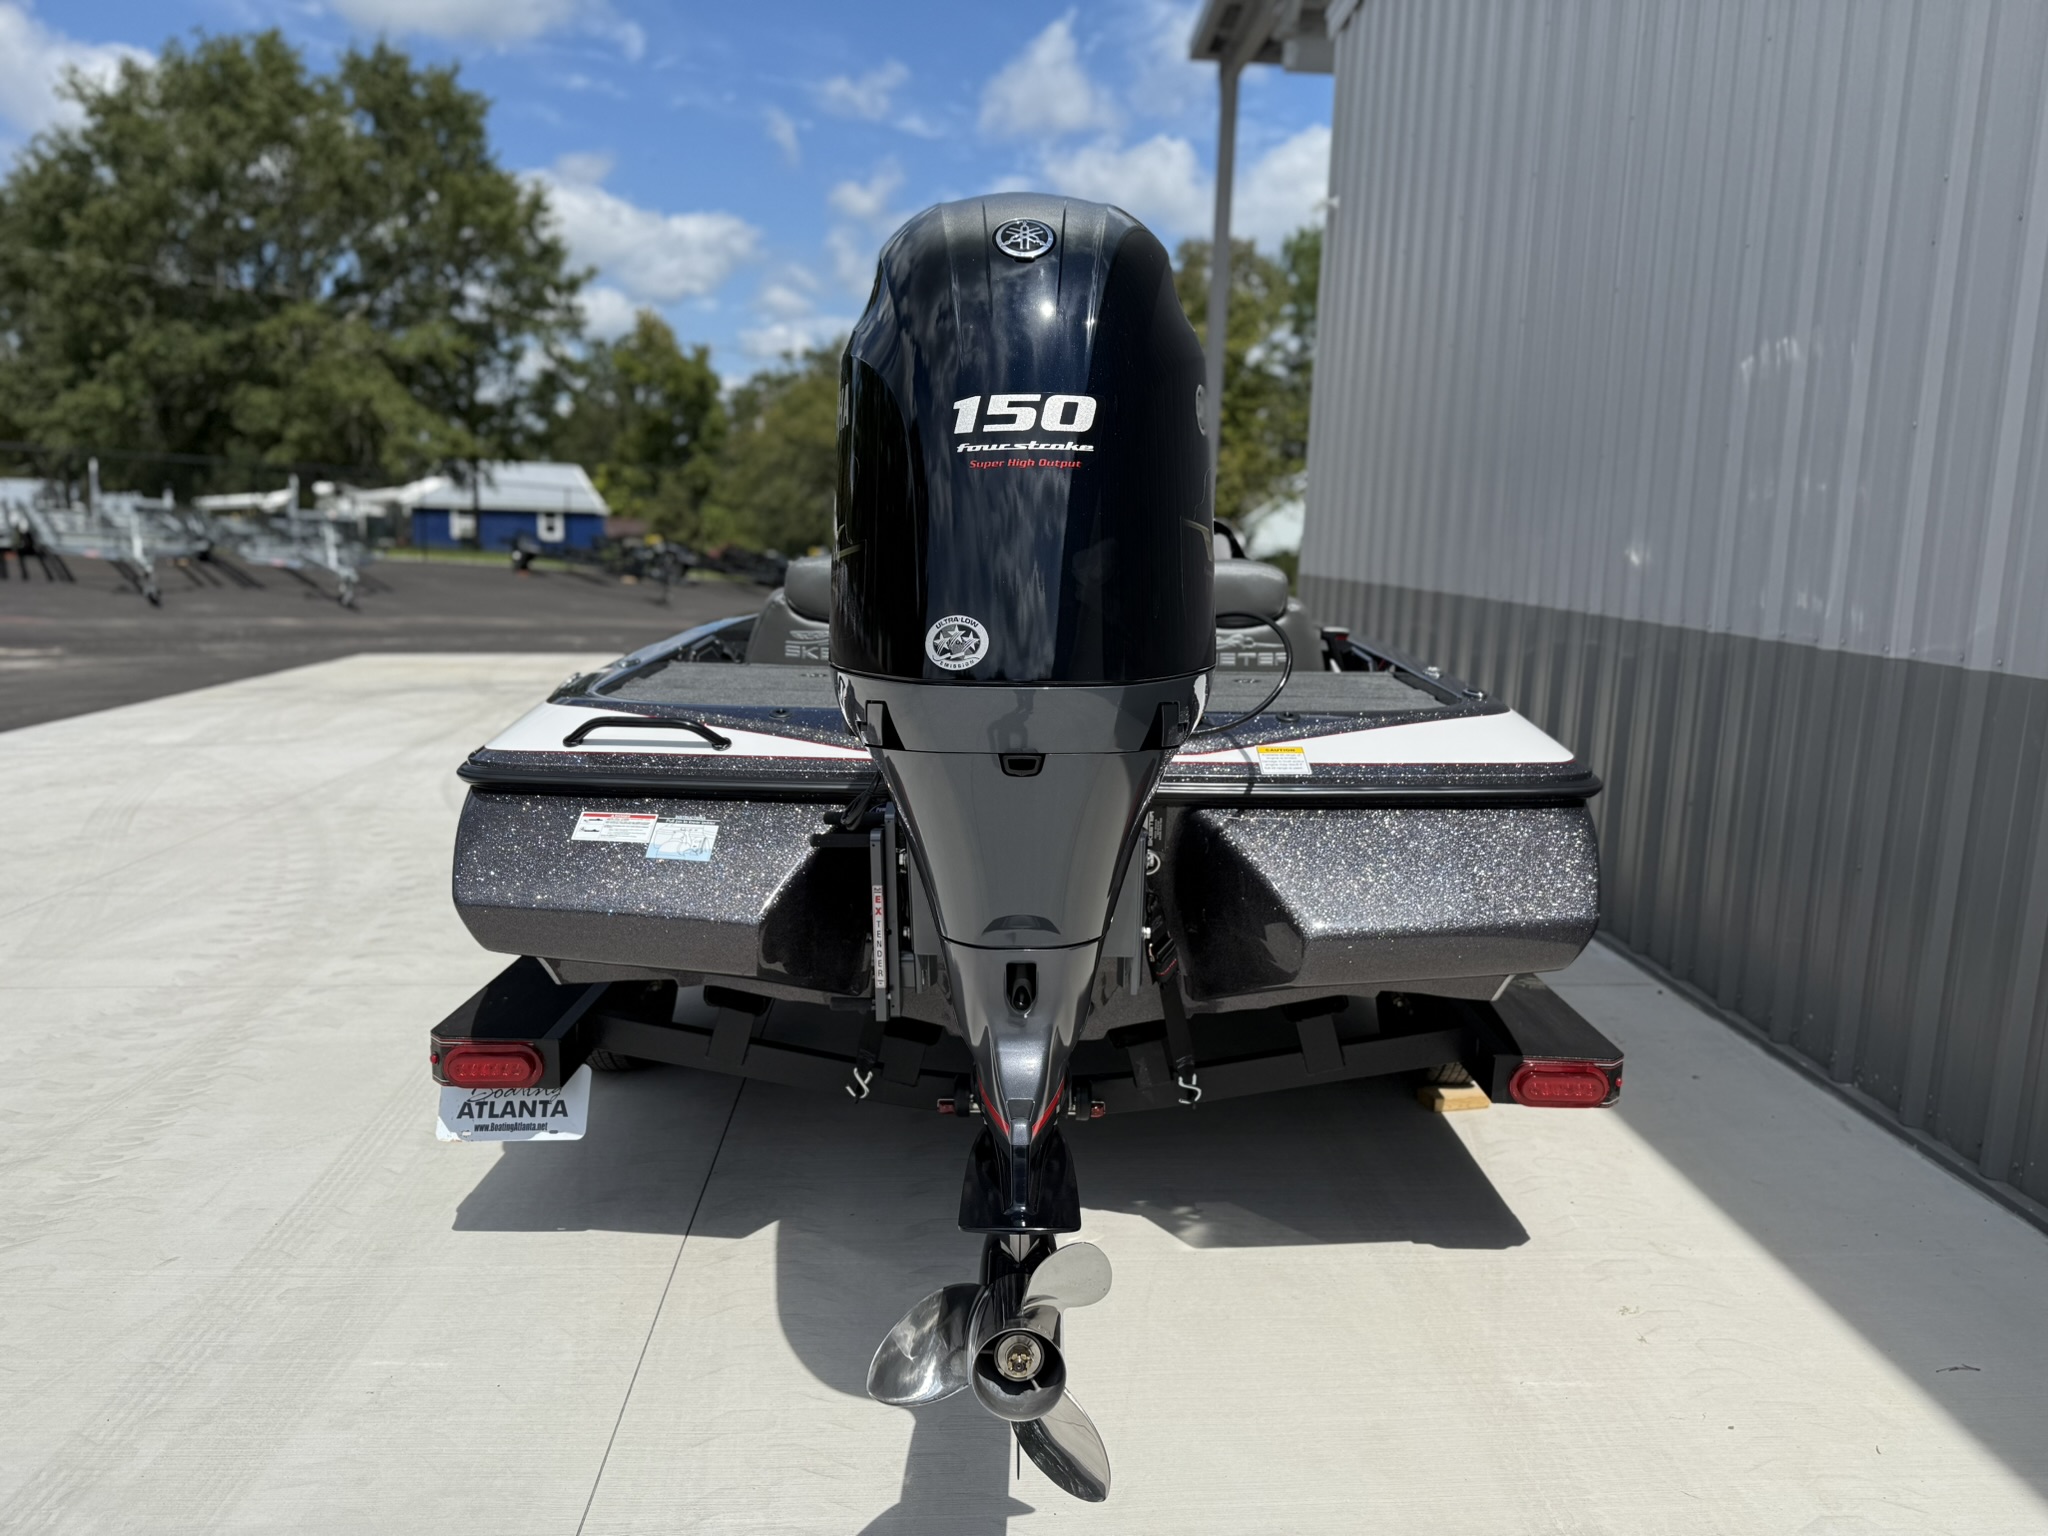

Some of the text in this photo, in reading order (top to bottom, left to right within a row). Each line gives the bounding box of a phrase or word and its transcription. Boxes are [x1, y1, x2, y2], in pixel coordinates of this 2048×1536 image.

[952, 394, 1097, 434] 150
[969, 458, 1083, 469] Super High Output
[935, 616, 979, 630] ULTRA LOW
[456, 1099, 569, 1119] ATLANTA
[474, 1121, 548, 1133] www.BoatingAtlanta.net
